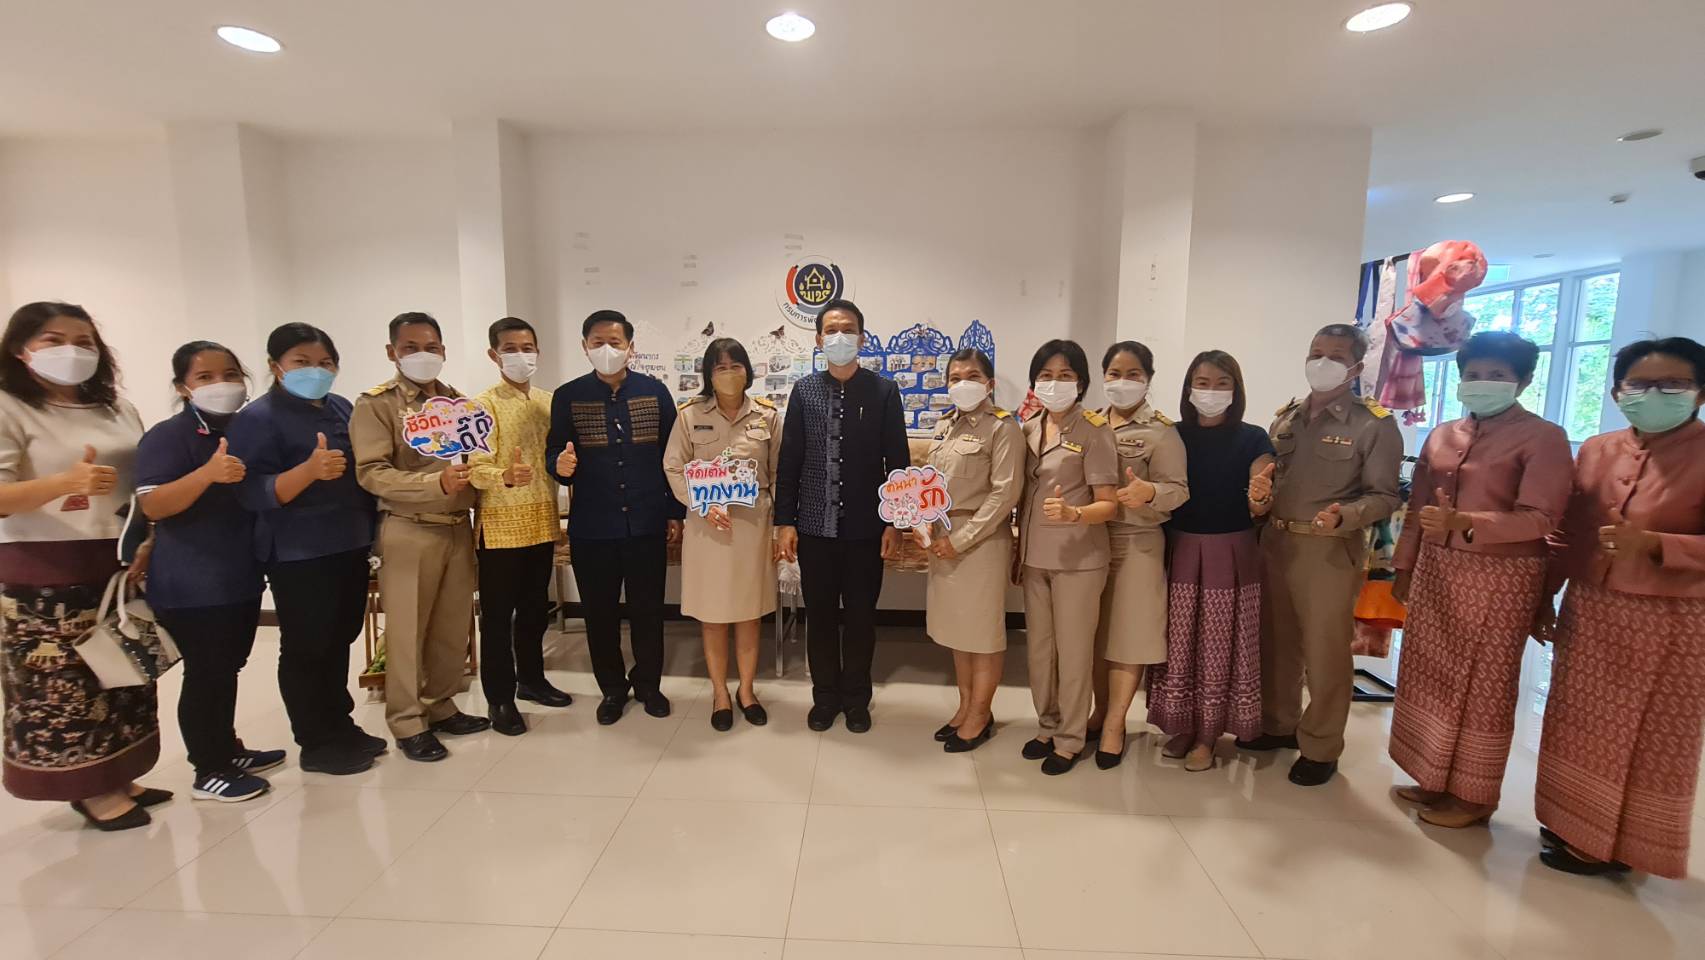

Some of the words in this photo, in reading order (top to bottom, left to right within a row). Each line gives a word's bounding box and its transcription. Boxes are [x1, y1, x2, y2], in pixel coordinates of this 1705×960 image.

[693, 481, 757, 513] ทุกงาน
[920, 473, 945, 509] รัก
